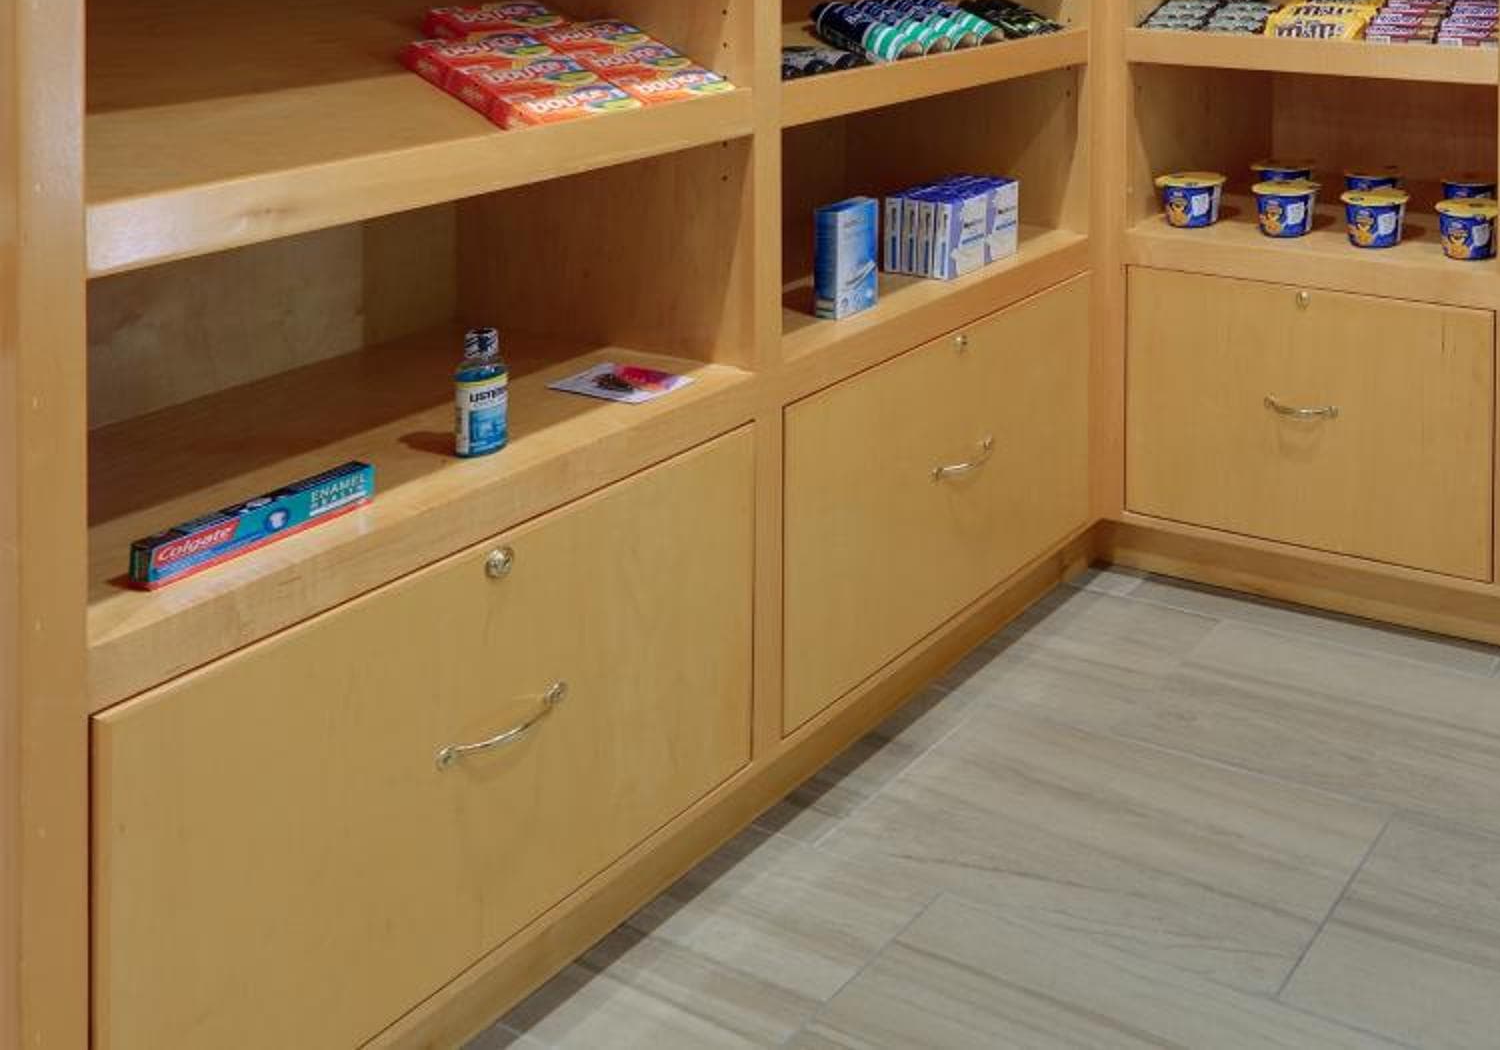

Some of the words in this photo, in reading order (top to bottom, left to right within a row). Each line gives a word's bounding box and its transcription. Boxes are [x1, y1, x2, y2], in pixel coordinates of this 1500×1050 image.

[526, 89, 609, 114] bounce
[469, 386, 506, 403] LISTE
[311, 473, 366, 502] ENAMEL
[157, 525, 235, 562] Colgate
